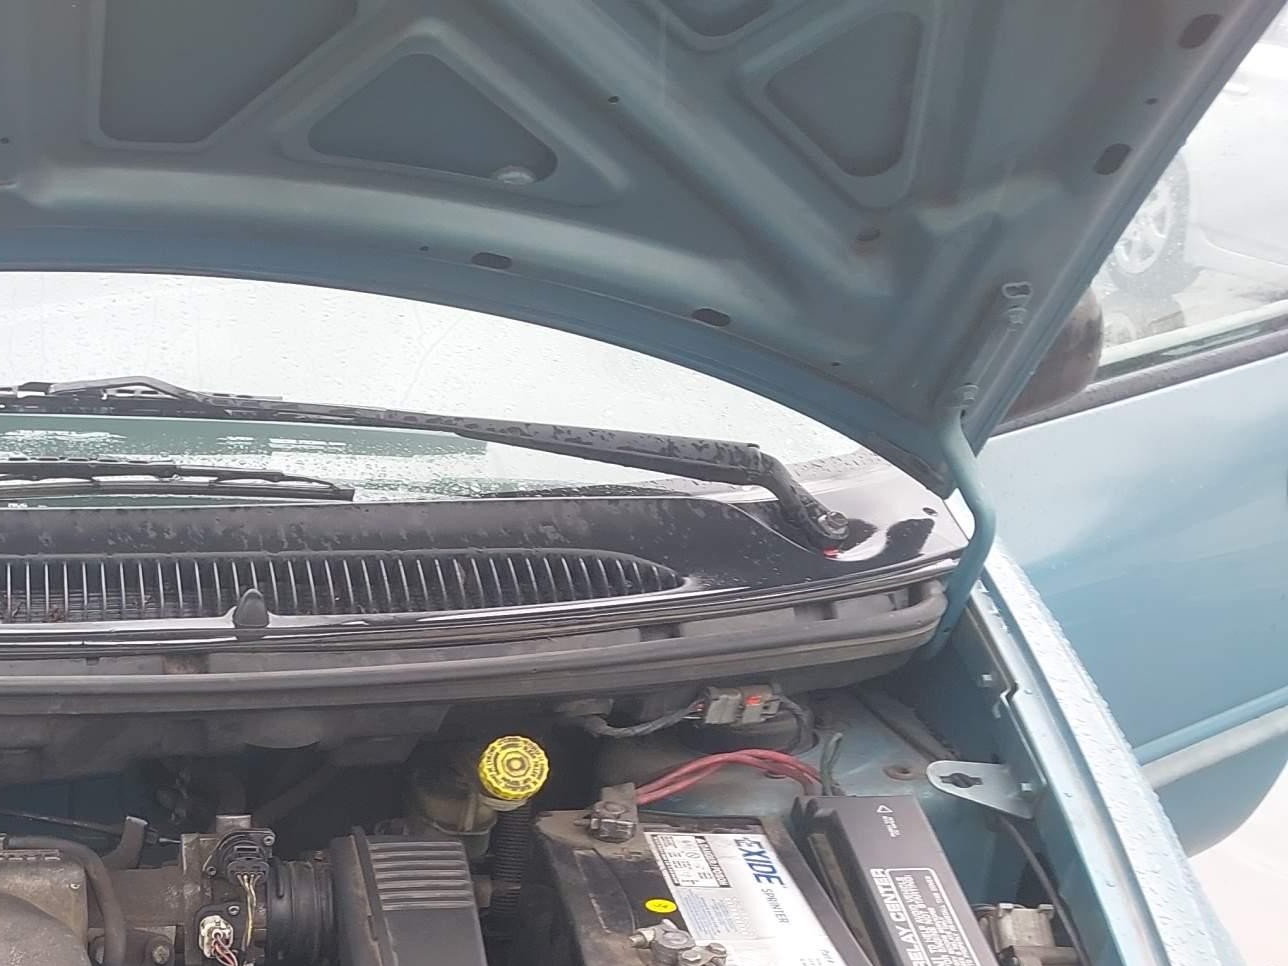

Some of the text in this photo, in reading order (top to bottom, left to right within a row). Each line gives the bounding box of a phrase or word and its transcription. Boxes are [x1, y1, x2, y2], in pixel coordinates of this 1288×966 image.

[733, 837, 785, 885] EXIDE
[761, 888, 791, 924] SPRINTER
[868, 868, 907, 921] CENTER
